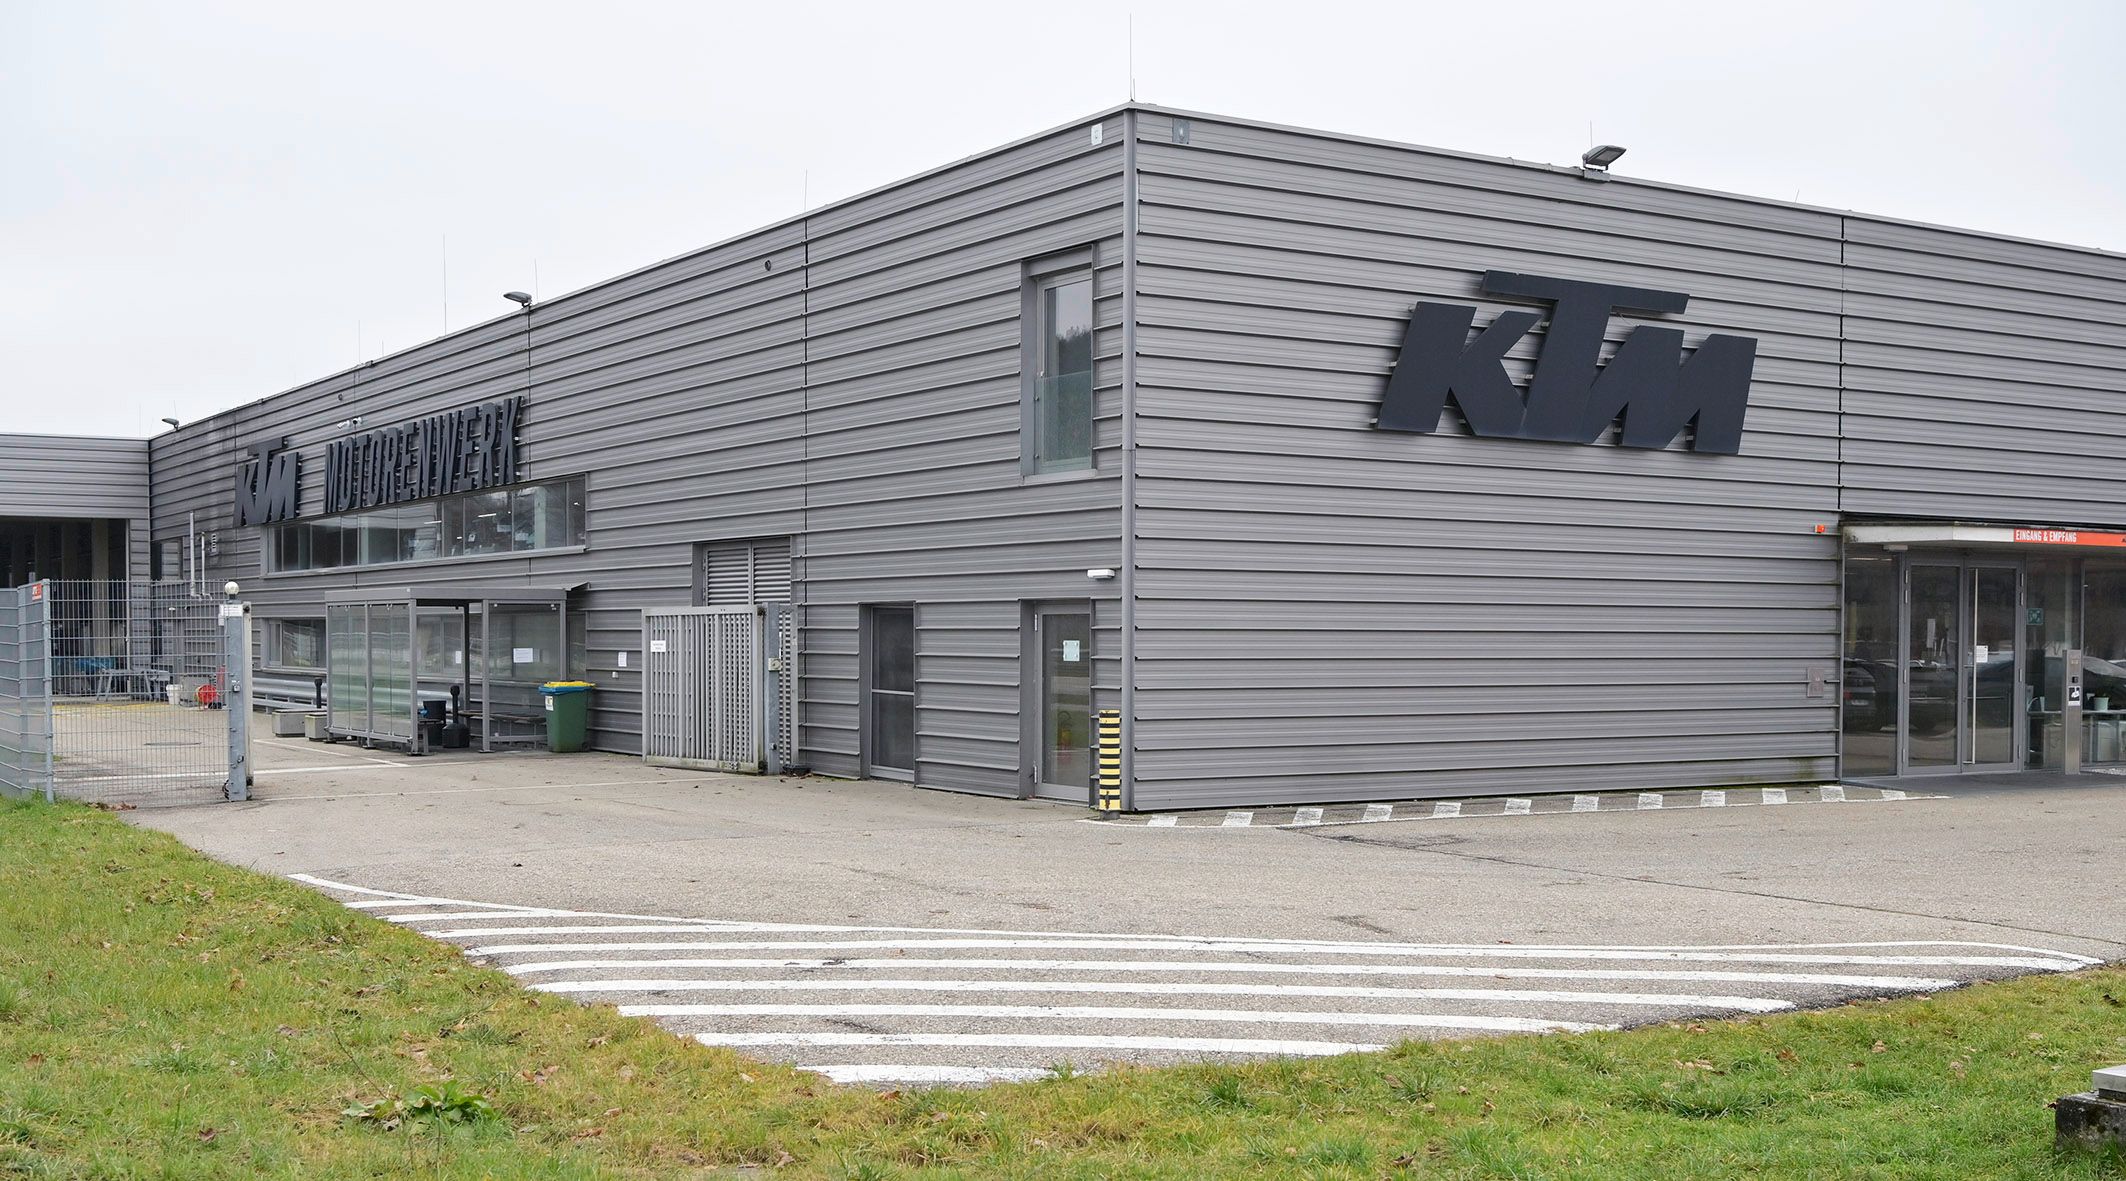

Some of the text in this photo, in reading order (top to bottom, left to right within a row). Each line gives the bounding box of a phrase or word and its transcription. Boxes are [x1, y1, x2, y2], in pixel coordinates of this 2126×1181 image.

[1377, 270, 1758, 455] KTM
[234, 396, 525, 526] KTM MOTORENWERK
[2015, 530, 2077, 543] EINGANG & EMPFANG
